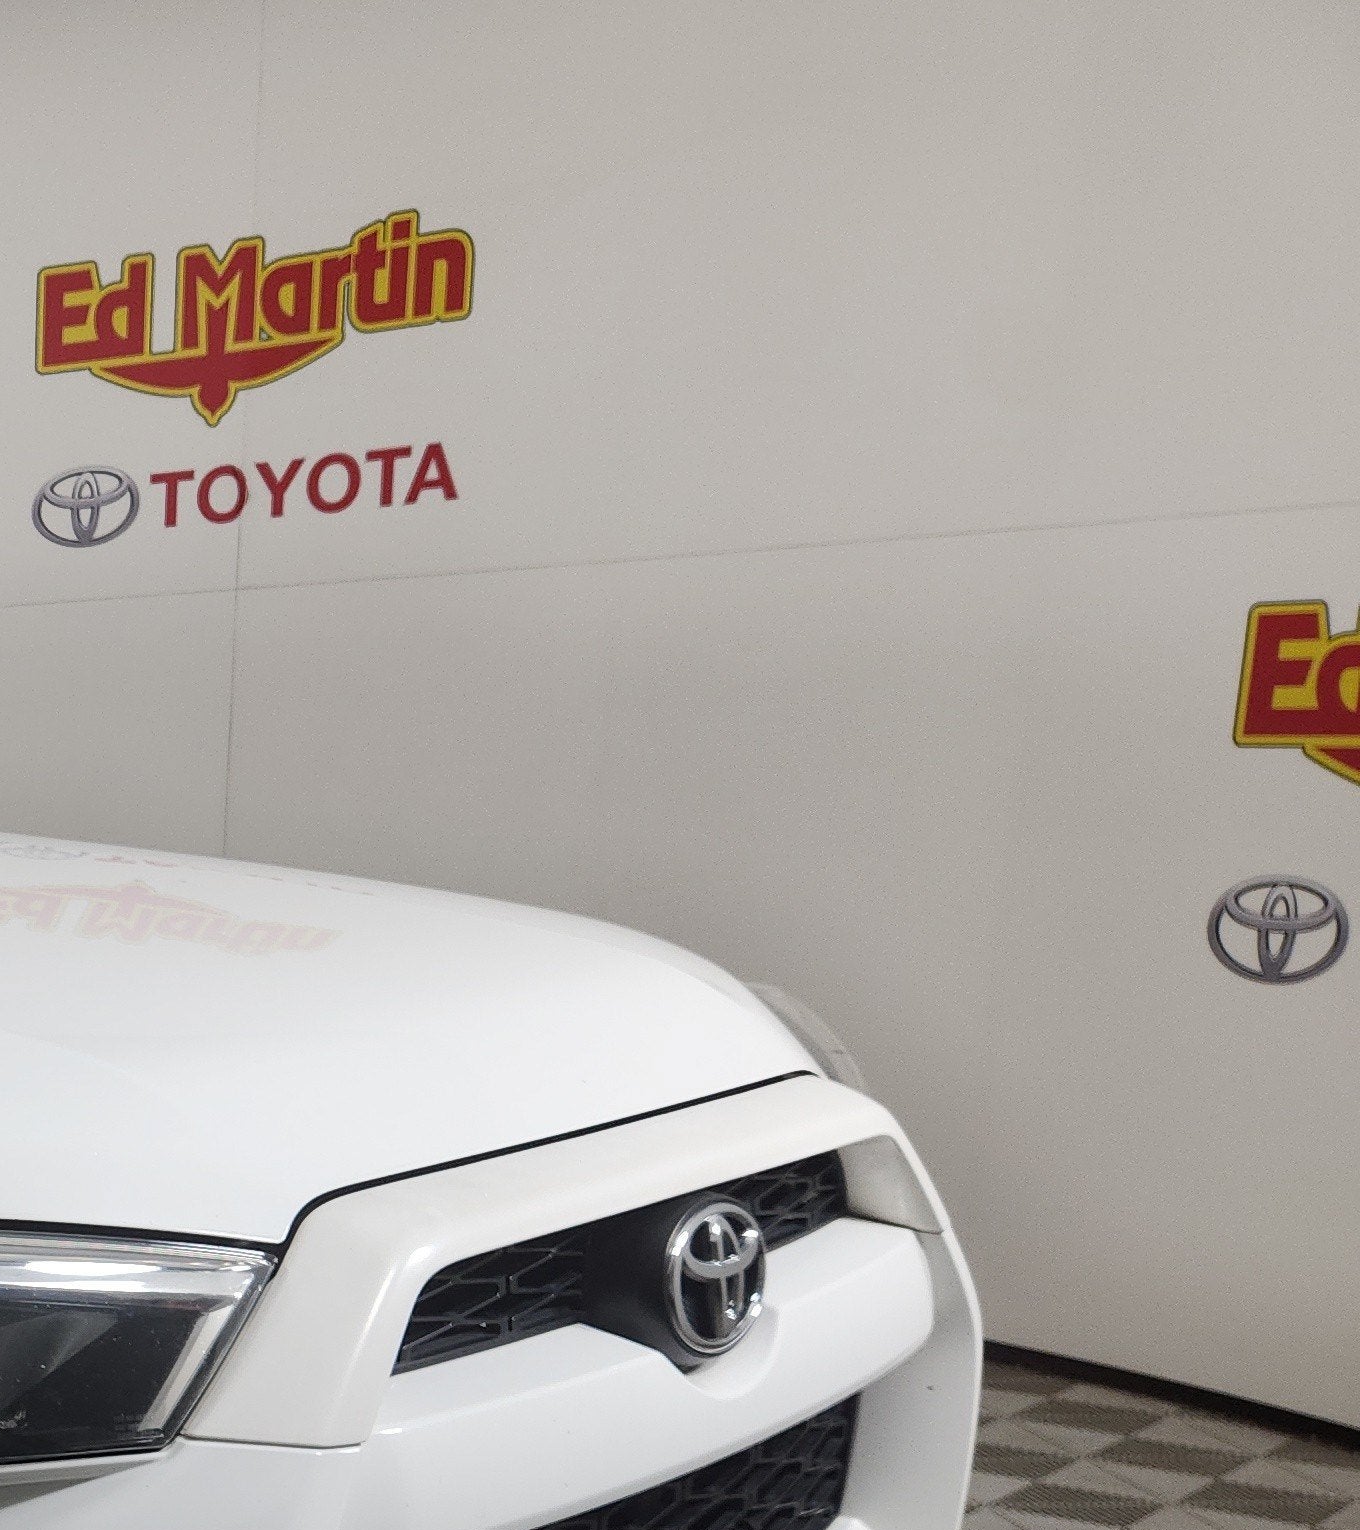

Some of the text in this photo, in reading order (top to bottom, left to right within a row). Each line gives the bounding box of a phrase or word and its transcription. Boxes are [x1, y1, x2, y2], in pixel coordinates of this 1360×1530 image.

[38, 211, 471, 371] Ed Martin
[149, 442, 459, 528] TOYOTA
